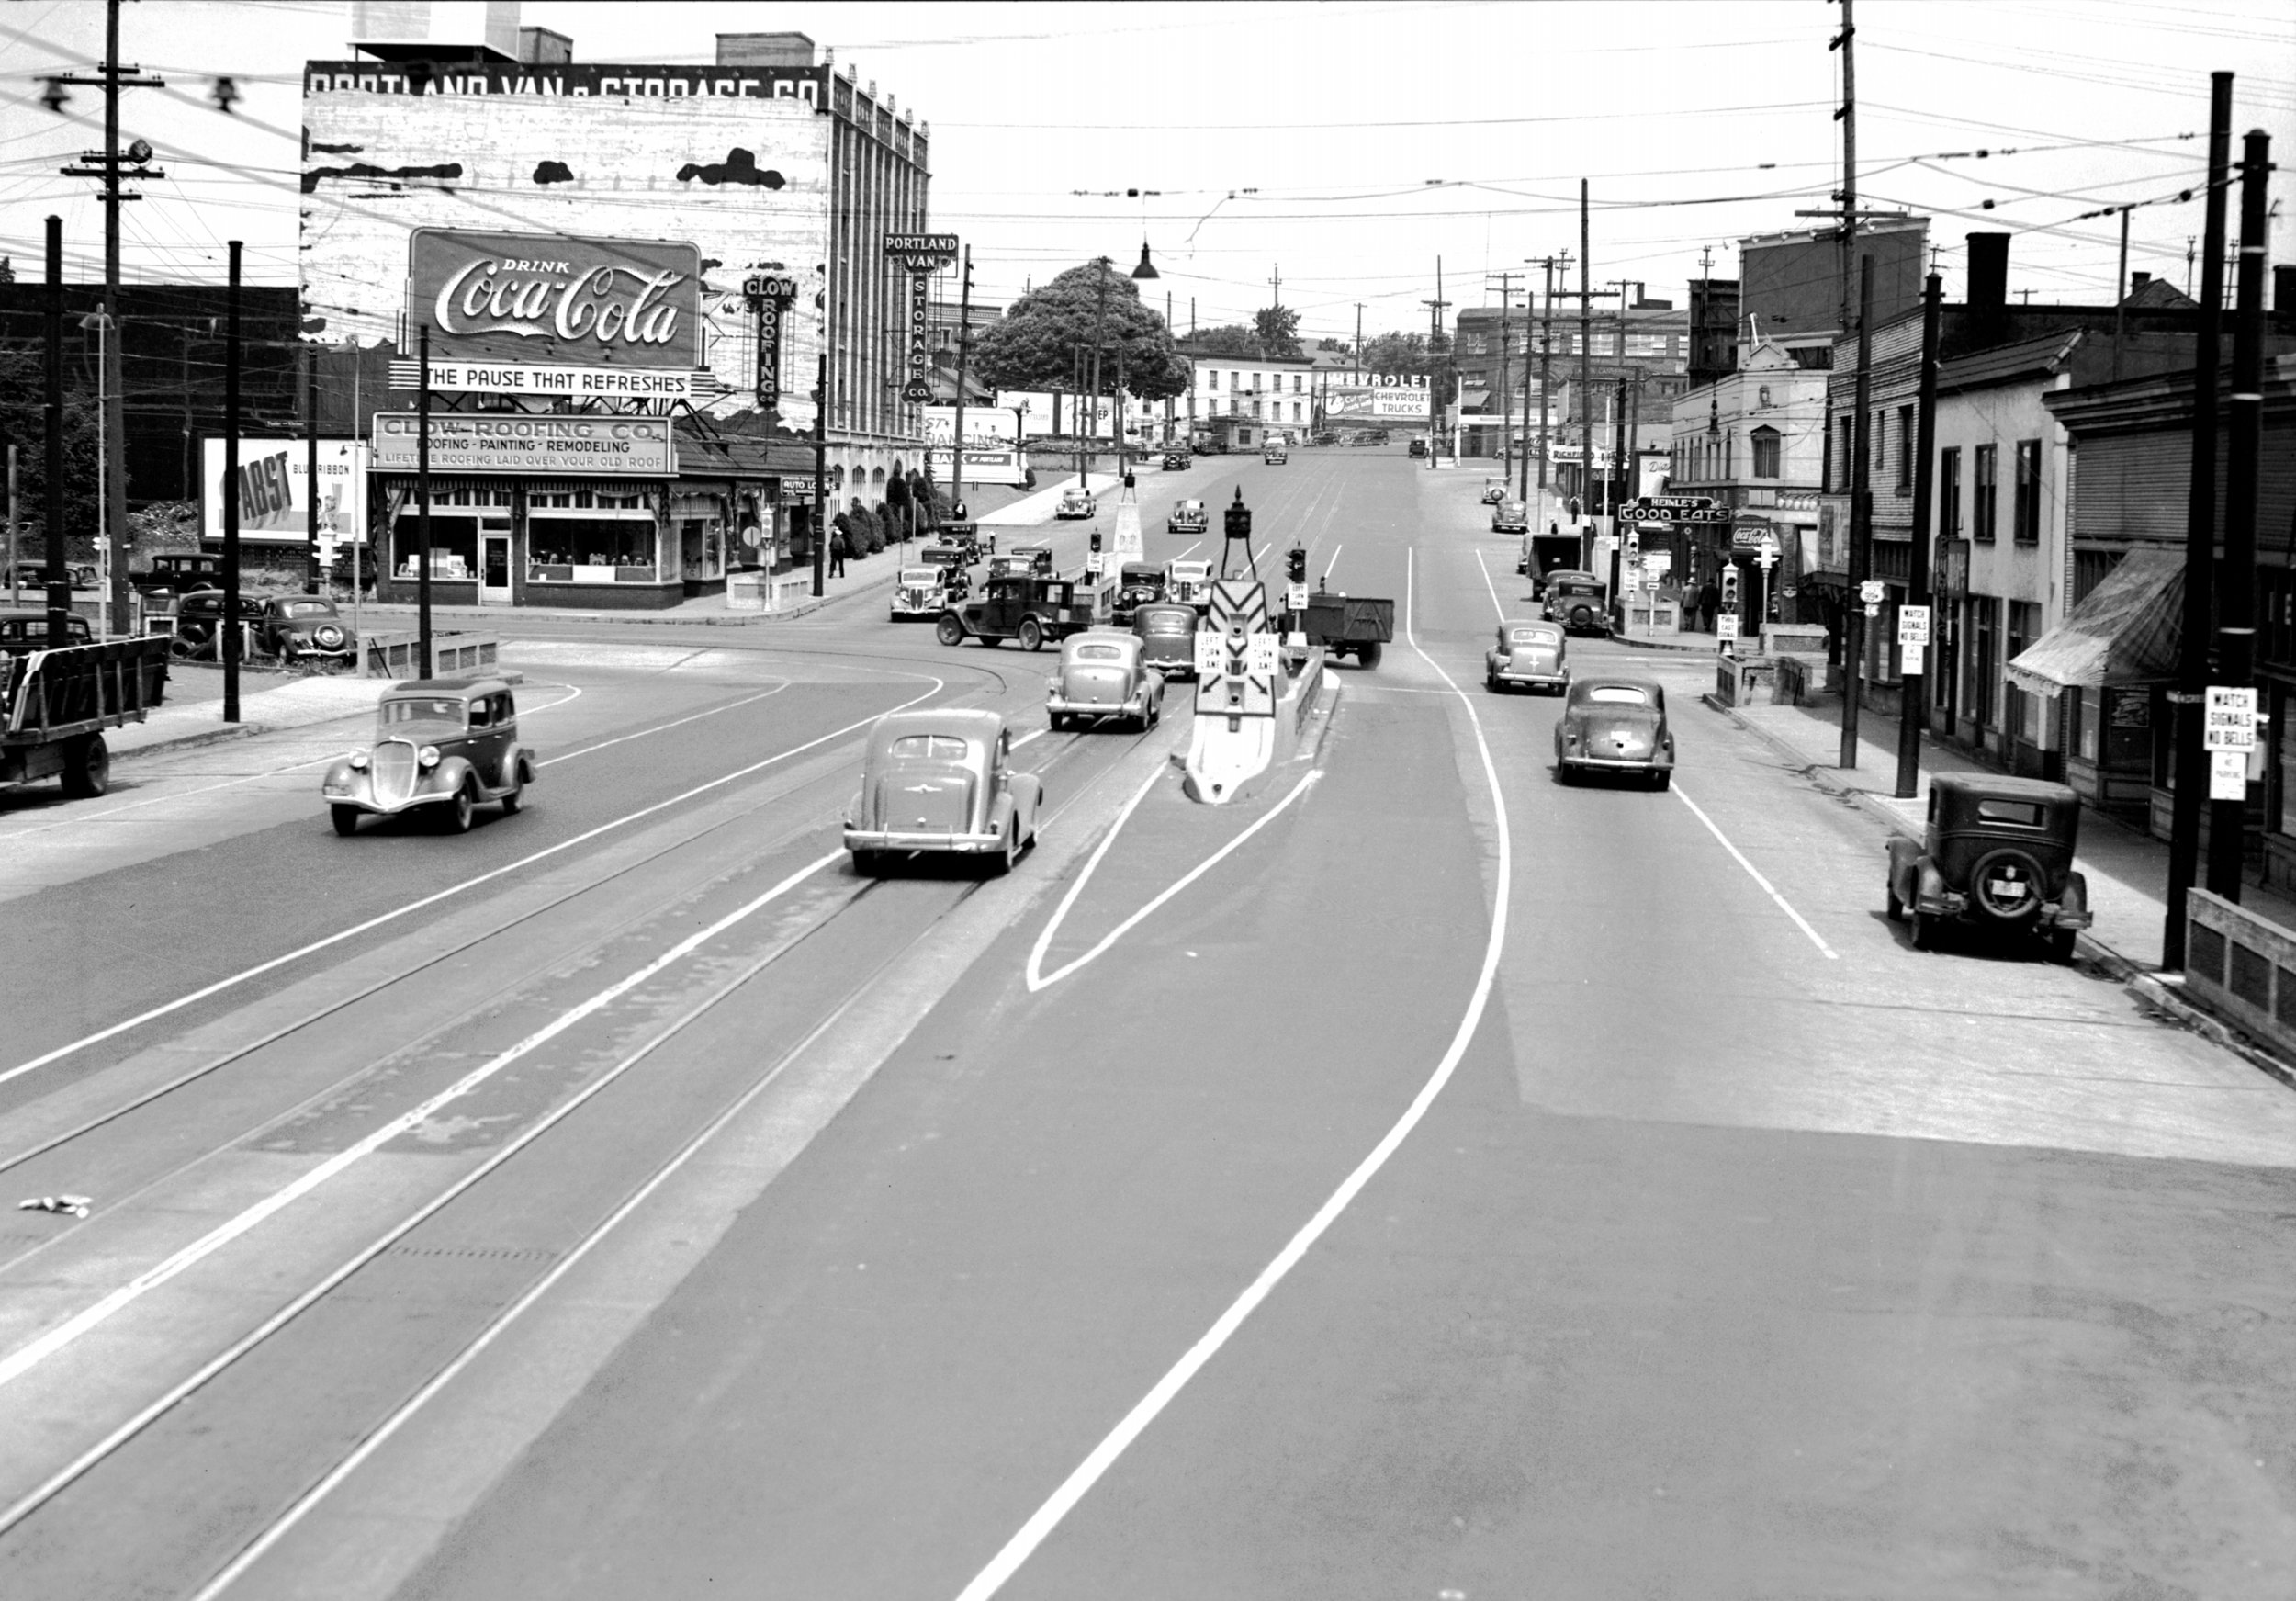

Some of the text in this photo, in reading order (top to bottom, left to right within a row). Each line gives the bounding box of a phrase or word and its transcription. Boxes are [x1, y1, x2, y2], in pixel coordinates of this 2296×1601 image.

[885, 236, 956, 251] PORTLAND
[502, 259, 569, 274] DRINK
[906, 254, 936, 267] VAN
[747, 280, 793, 296] CLOW
[434, 258, 689, 344] Coca-Cola
[913, 280, 926, 379] STORAGE
[761, 299, 776, 394] ROOFING
[428, 368, 686, 392] THE PAUSE THAT REFRESHES
[1382, 403, 1422, 413] TRUCKS
[384, 419, 459, 437] CLOW
[473, 422, 594, 439] ROOFING
[480, 440, 535, 451] PAINTING
[547, 441, 630, 453] REMODELING
[385, 453, 661, 468] LIFETIE ROOFING LAID OVER YOUR OLD ROOF
[237, 450, 292, 520] ABST
[783, 480, 805, 489] AUTO
[1622, 508, 1728, 521] GOOD EATS
[1904, 609, 1925, 619] WATCH
[1902, 621, 1927, 630] SIGNALS
[1200, 637, 1219, 646] LEFT
[1254, 637, 1272, 647] LEFT
[1900, 632, 1928, 642] NO BELLS
[1200, 660, 1220, 670] LANE
[1253, 661, 1272, 671] LANE
[2213, 693, 2248, 707] WATCH
[2210, 712, 2252, 727] SIGNALS
[2208, 730, 2253, 746] NO BELLS
